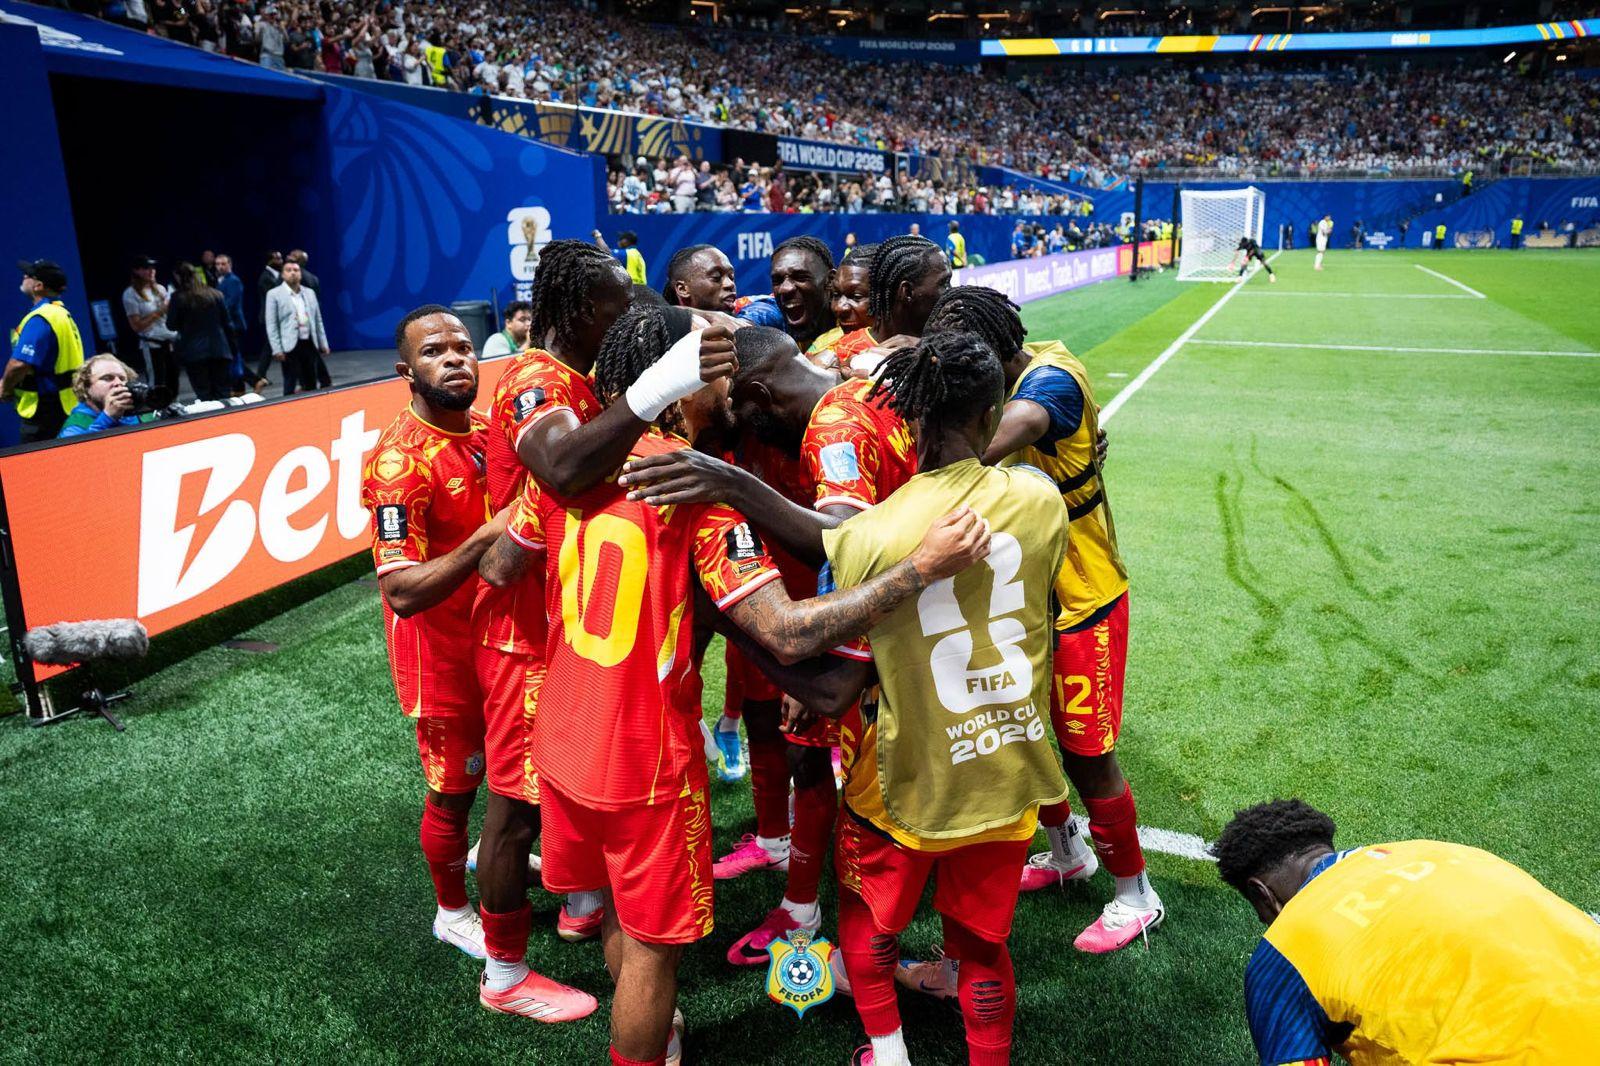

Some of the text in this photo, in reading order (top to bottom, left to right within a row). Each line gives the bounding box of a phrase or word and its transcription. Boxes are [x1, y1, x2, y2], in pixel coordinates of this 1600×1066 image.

[799, 144, 836, 167] WORLD
[836, 149, 855, 168] CUP
[855, 152, 885, 172] 2026
[1571, 196, 1599, 208] FIFA
[738, 231, 775, 260] FIFA
[559, 508, 649, 667] 10
[966, 671, 1016, 694] FIFA
[1055, 674, 1093, 715] 12
[945, 698, 1038, 740] WORLD CU
[950, 716, 1045, 766] 2026
